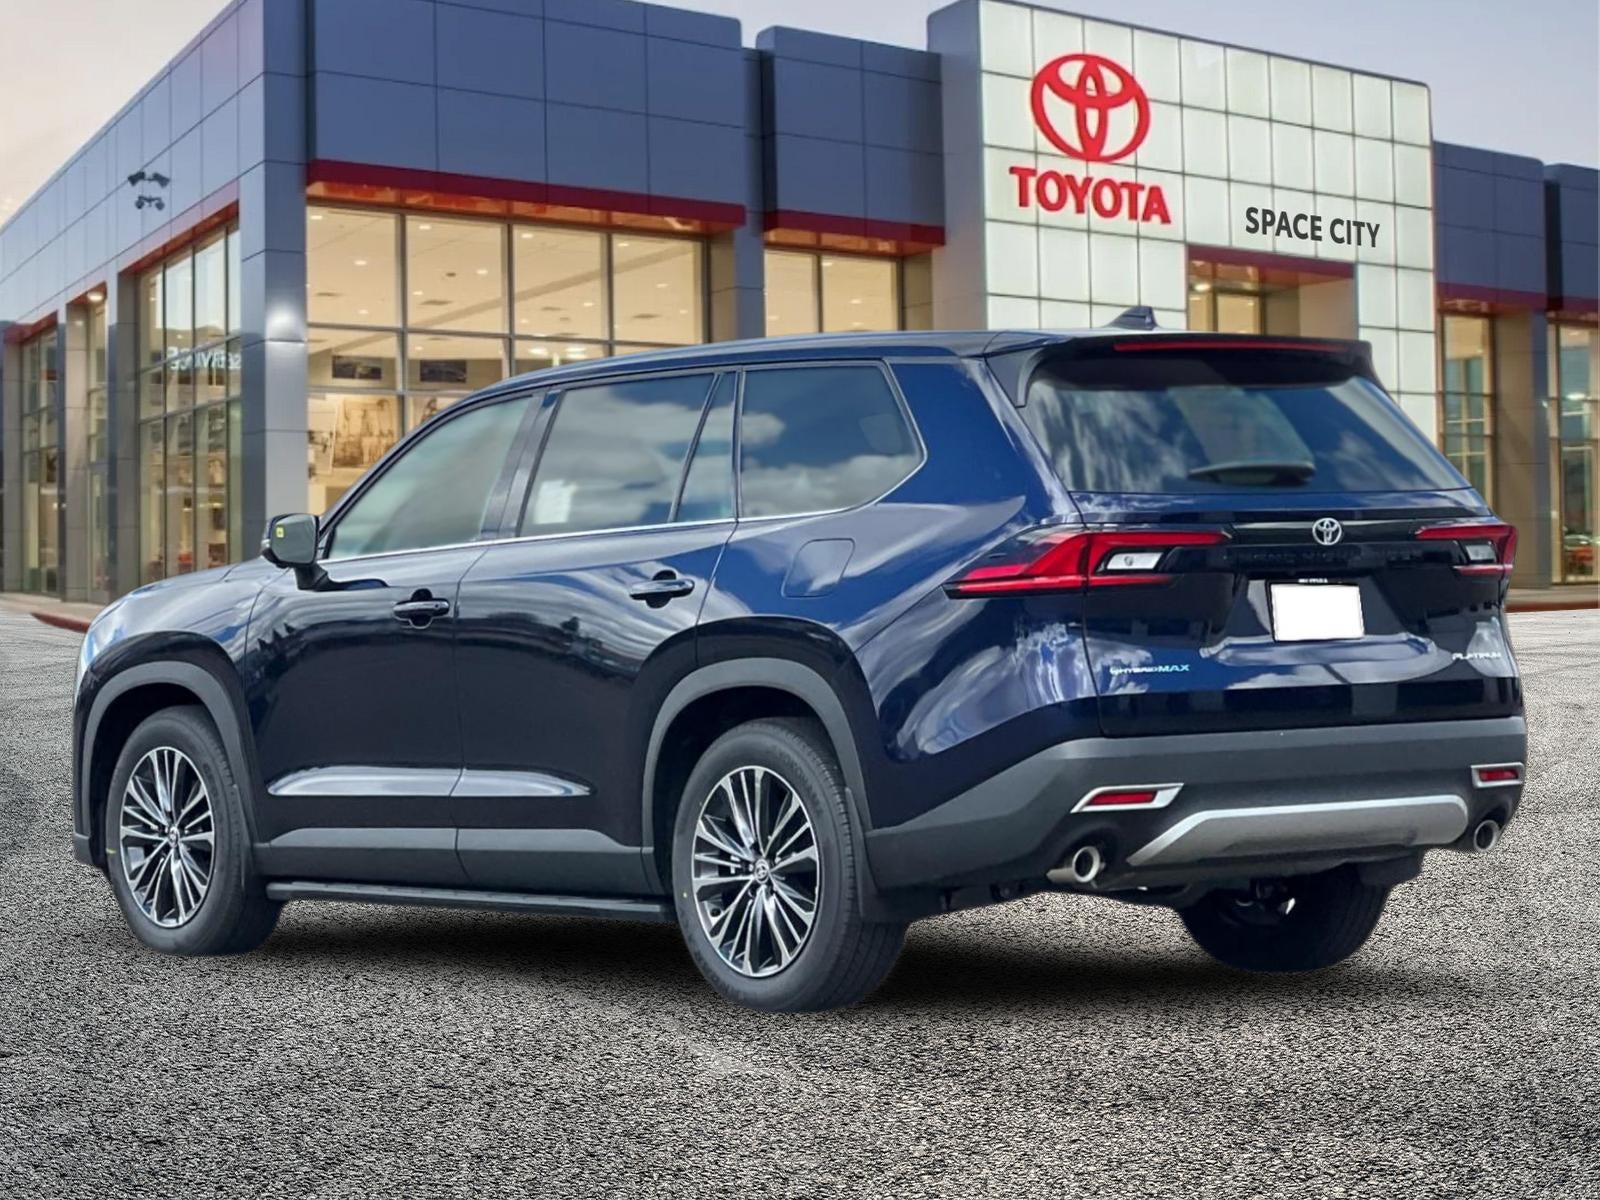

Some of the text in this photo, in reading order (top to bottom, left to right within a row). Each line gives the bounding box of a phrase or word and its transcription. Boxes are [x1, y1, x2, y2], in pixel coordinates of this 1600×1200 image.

[1009, 166, 1171, 224] TOYOTA
[1245, 206, 1380, 247] SPACE CITY
